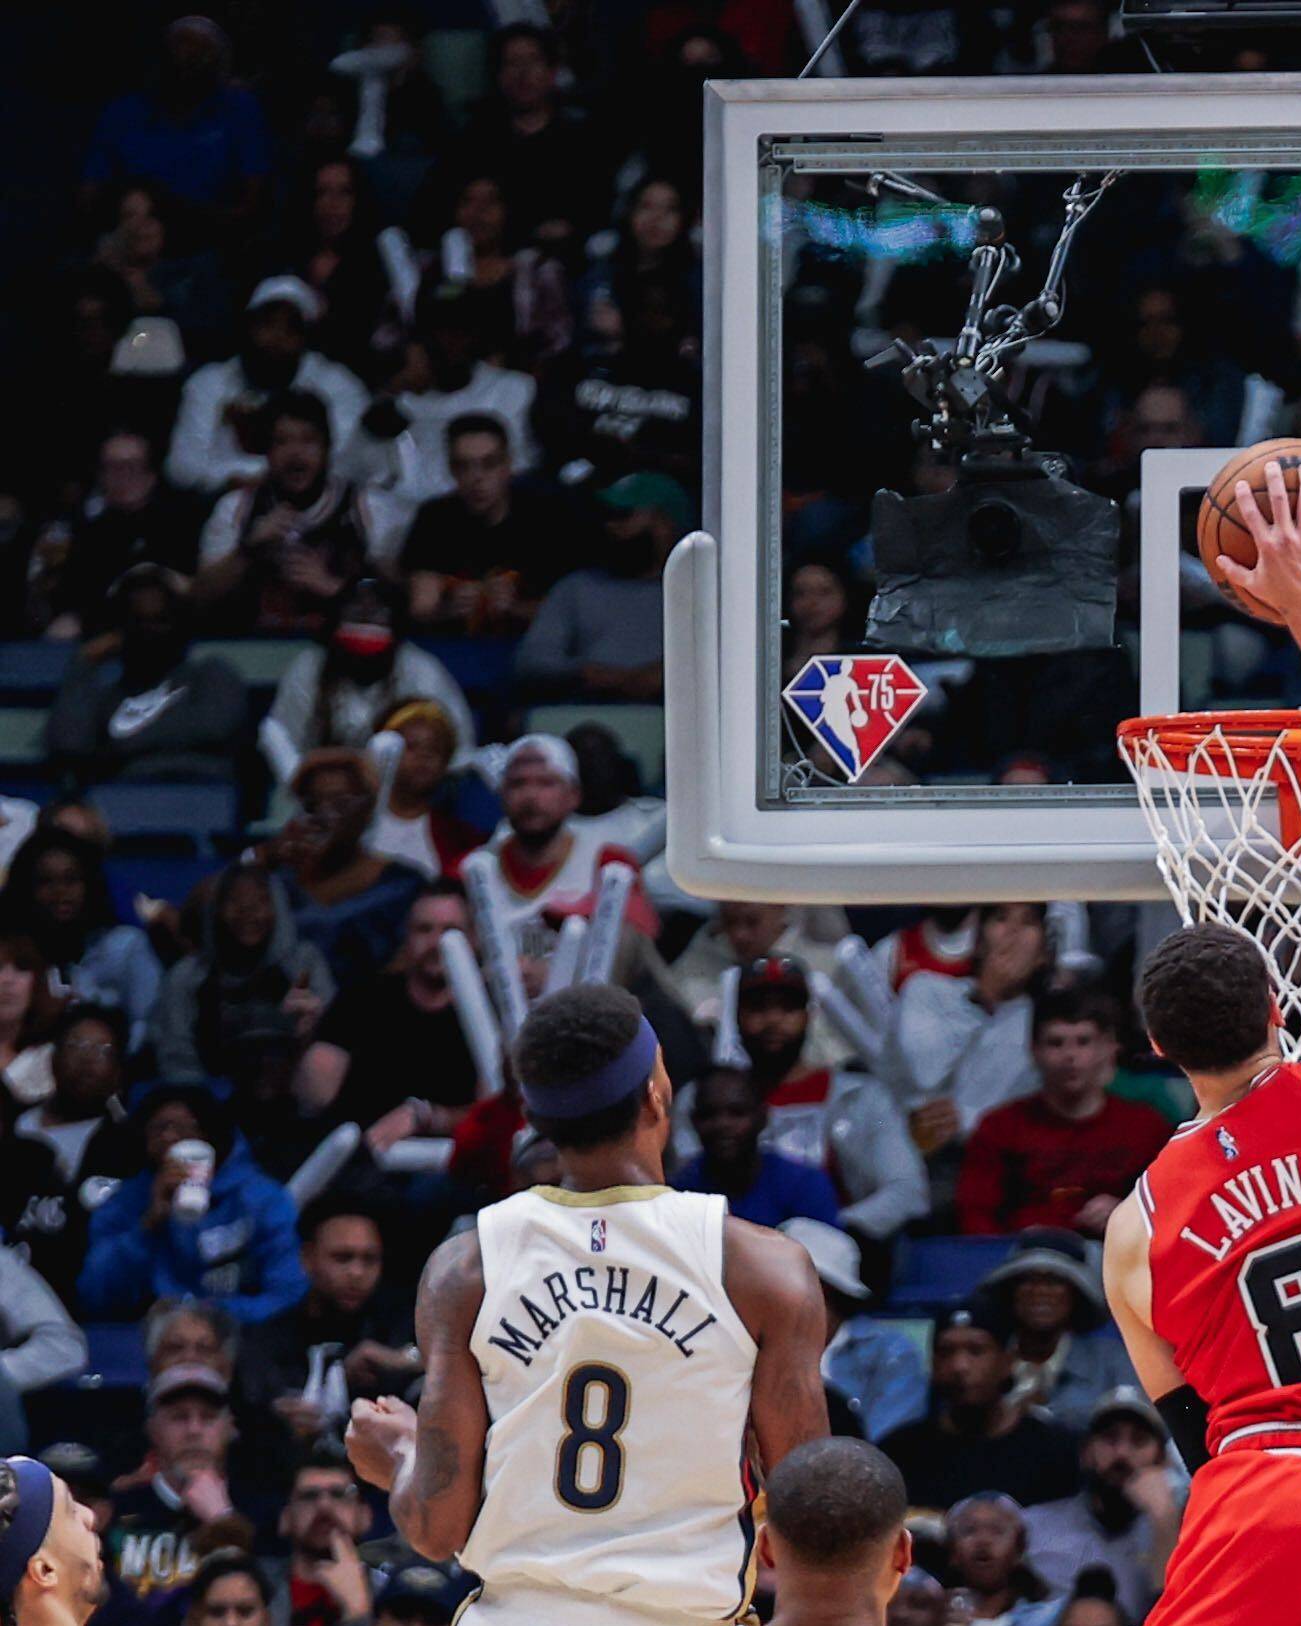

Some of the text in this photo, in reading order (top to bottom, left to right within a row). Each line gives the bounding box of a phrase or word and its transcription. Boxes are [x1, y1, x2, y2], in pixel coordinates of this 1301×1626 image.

[867, 673, 895, 710] 75
[488, 1265, 718, 1368] MARSHALL
[553, 1359, 633, 1515] 8
